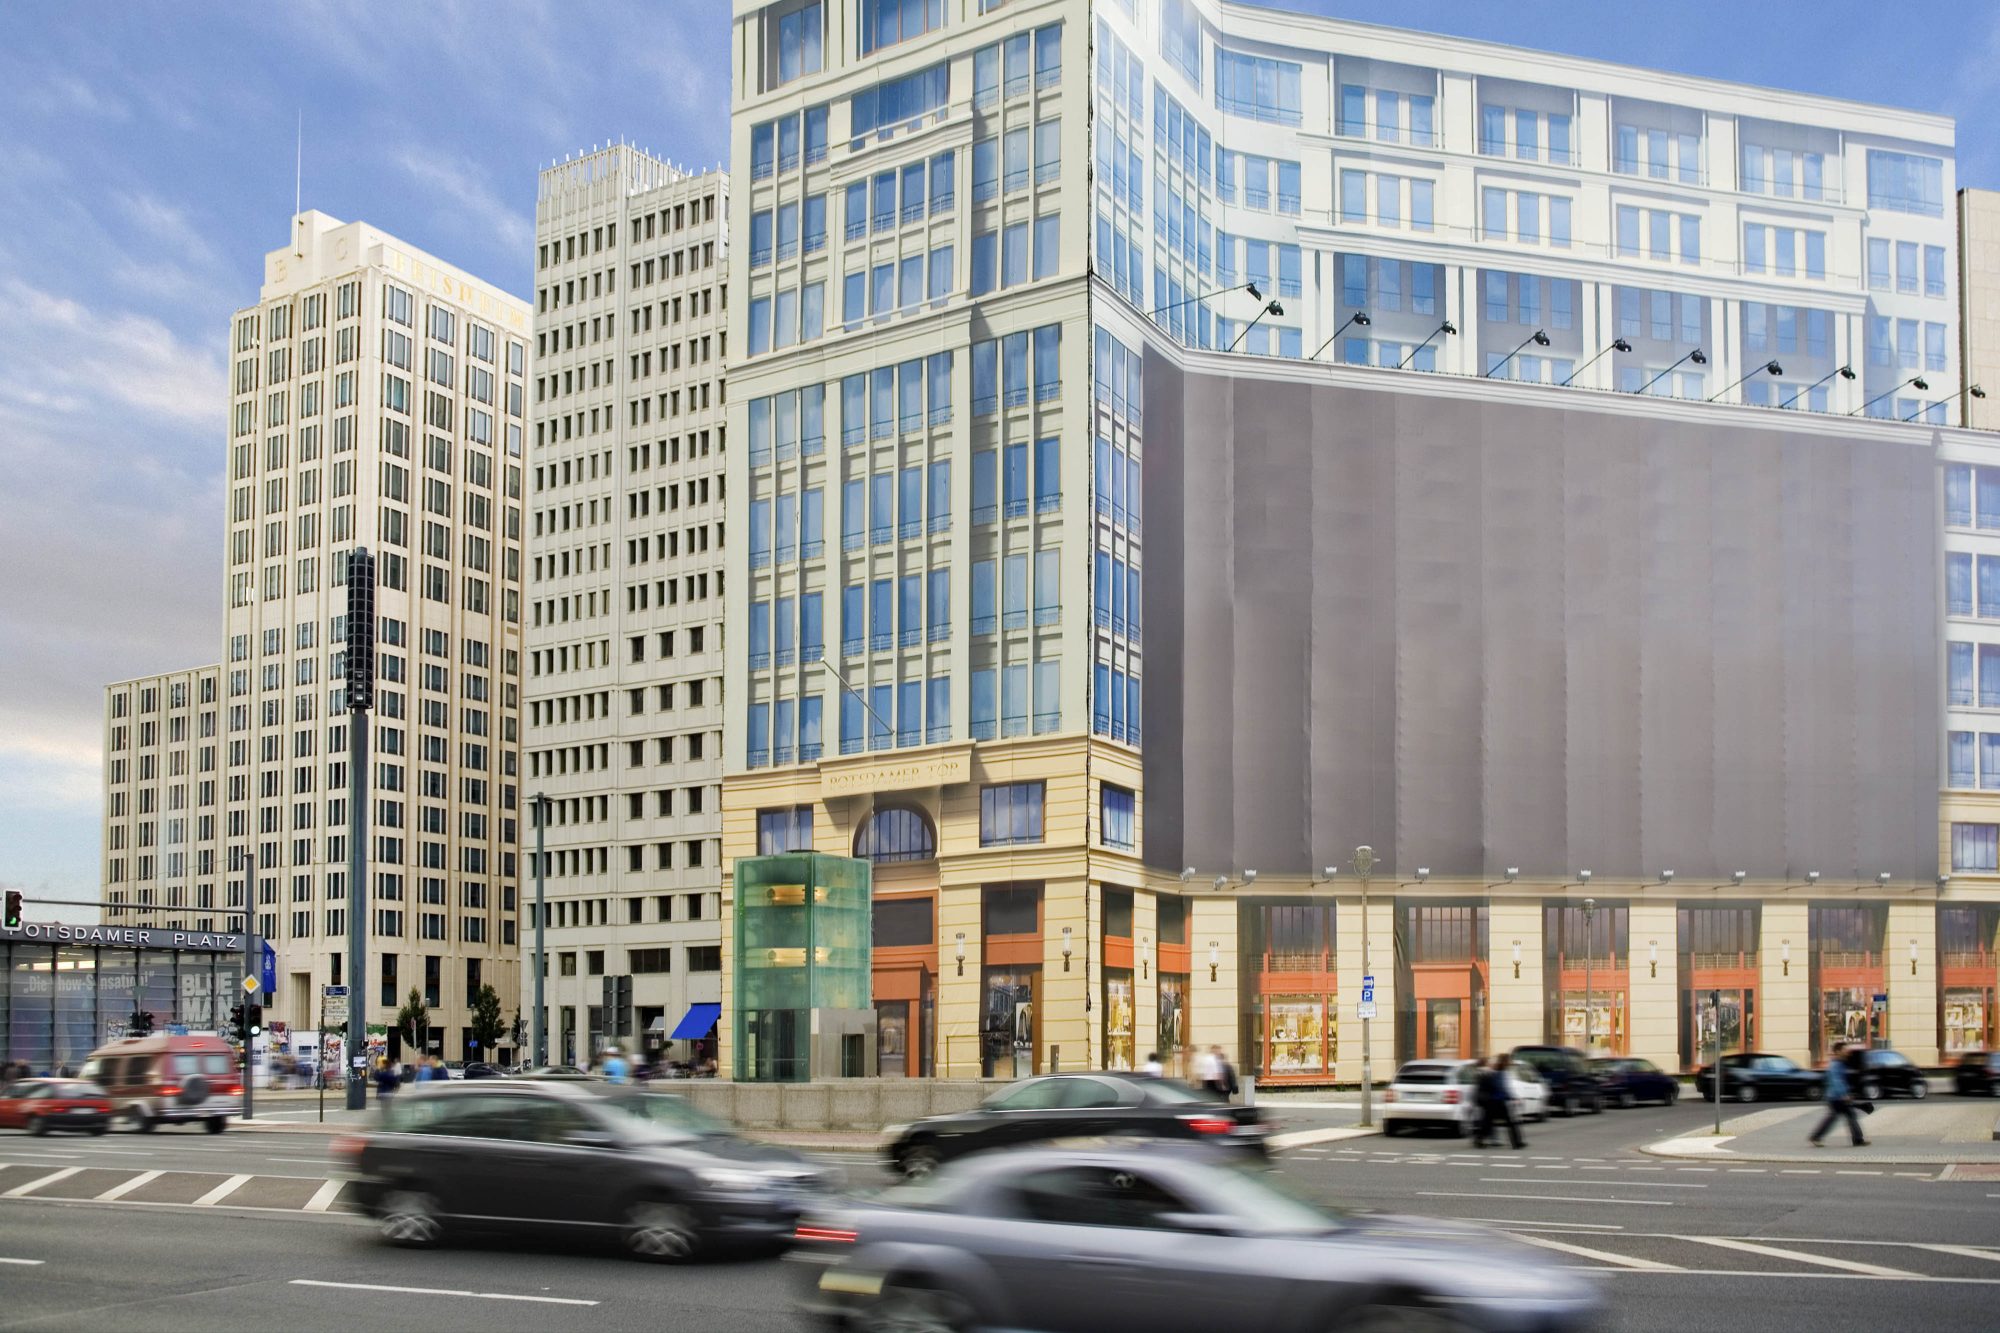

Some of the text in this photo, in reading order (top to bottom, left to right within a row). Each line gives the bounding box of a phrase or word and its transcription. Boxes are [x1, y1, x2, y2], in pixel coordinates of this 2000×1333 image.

[8, 924, 237, 948] OTSDAMER PLATZ
[181, 972, 233, 996] BLUE
[182, 995, 233, 1022] MAN
